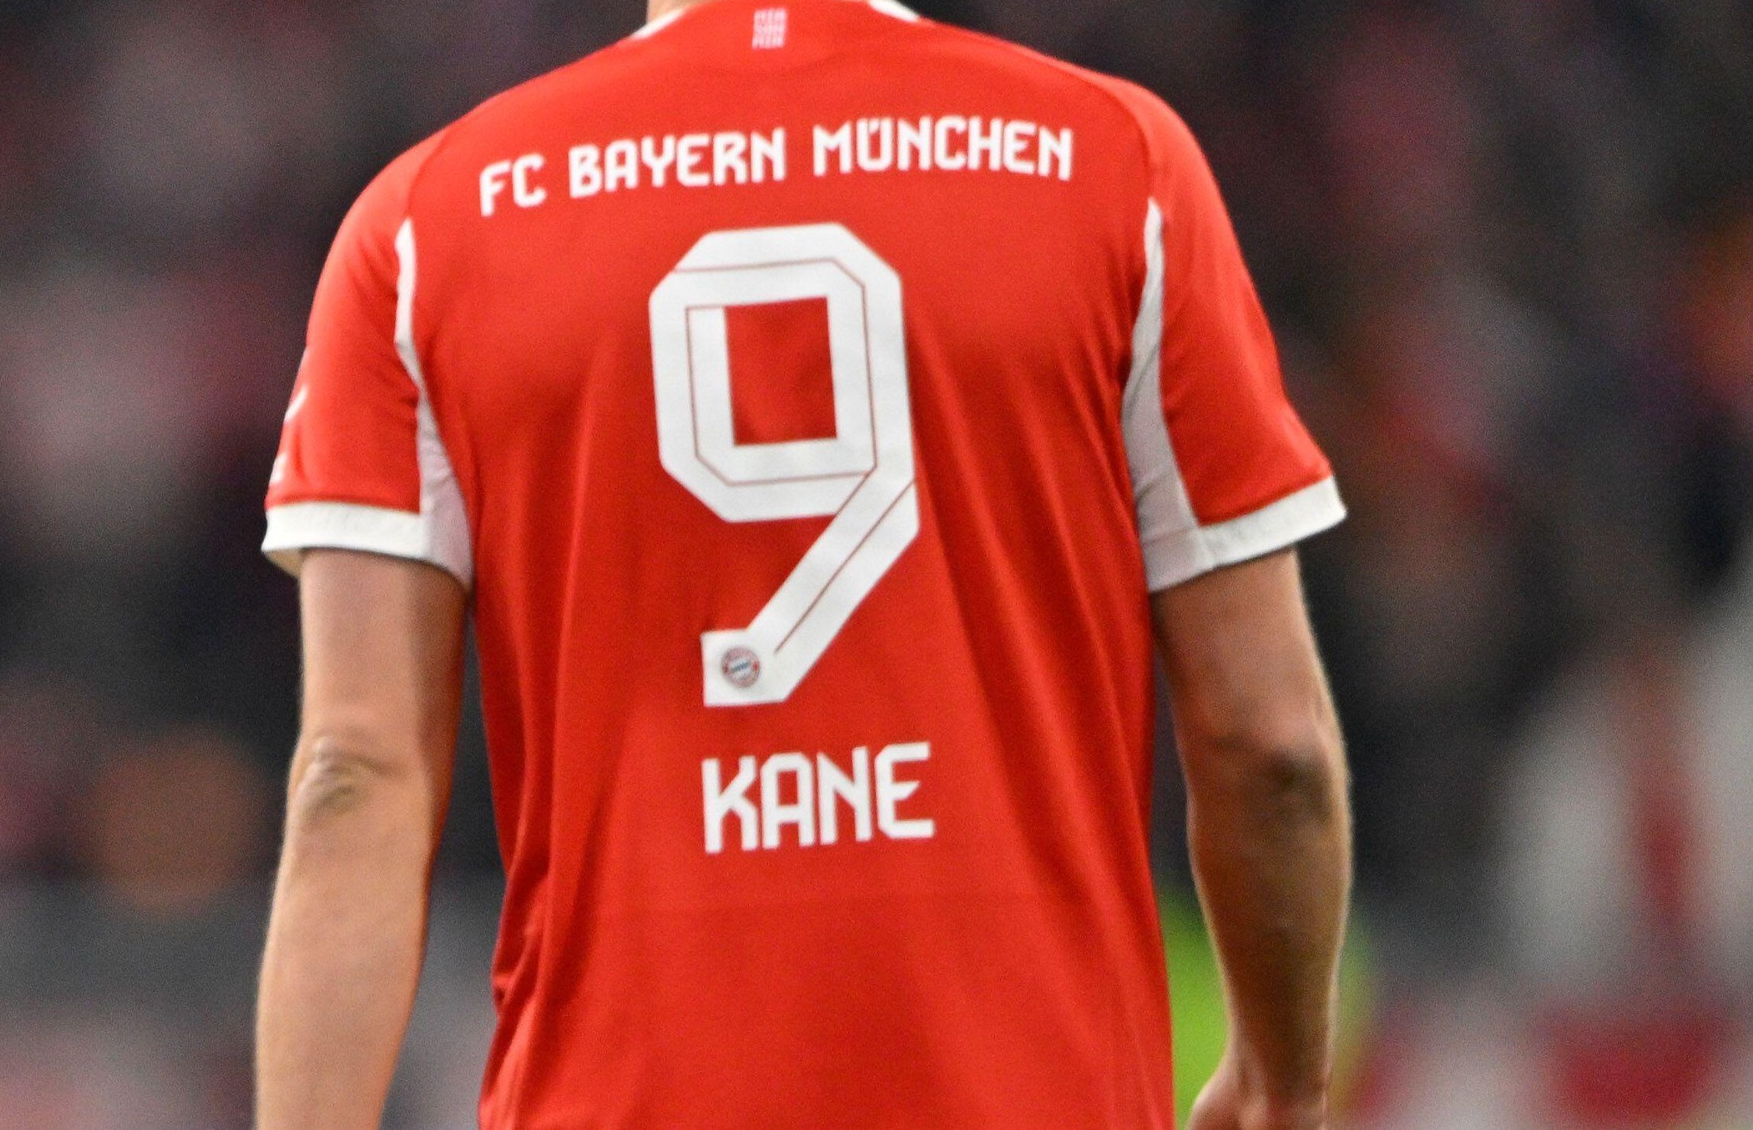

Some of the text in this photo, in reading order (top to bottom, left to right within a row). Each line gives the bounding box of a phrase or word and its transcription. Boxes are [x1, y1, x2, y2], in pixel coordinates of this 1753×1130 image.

[479, 115, 1074, 217] FC BAYERN MÜNCHEN
[648, 223, 920, 707] 9
[702, 742, 934, 853] KANE
